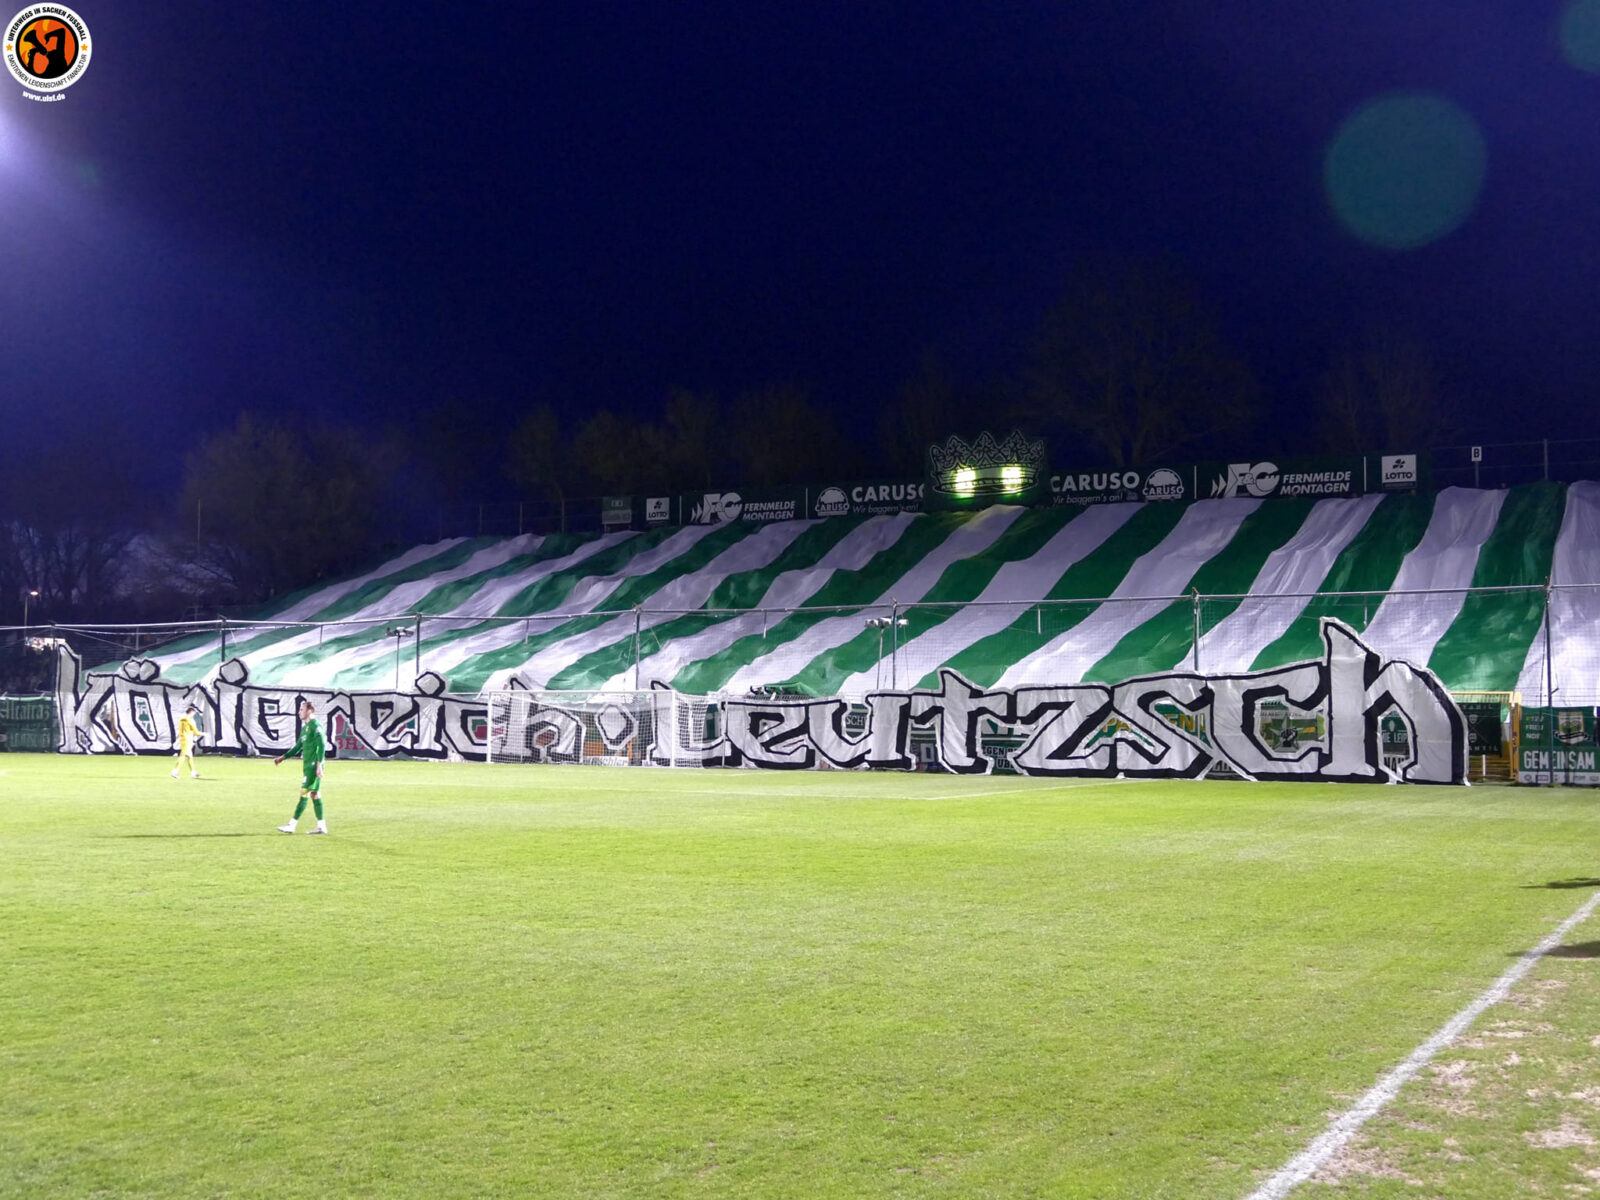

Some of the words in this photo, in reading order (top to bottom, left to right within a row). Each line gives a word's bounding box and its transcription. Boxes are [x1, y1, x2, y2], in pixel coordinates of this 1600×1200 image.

[1473, 448, 1480, 458] B
[1283, 471, 1351, 484] FERNMELDE
[1385, 471, 1413, 480] LOTTO
[1050, 471, 1140, 493] CARUSO
[1142, 485, 1185, 496] CARUSO
[1280, 482, 1350, 496] MONTAGEN
[744, 500, 796, 512] FERNMELDE
[815, 502, 850, 513] CARUSO
[648, 511, 668, 519] LOTTO
[742, 510, 795, 522] MONTAGEN
[1523, 750, 1595, 770] GEMEINSAM
